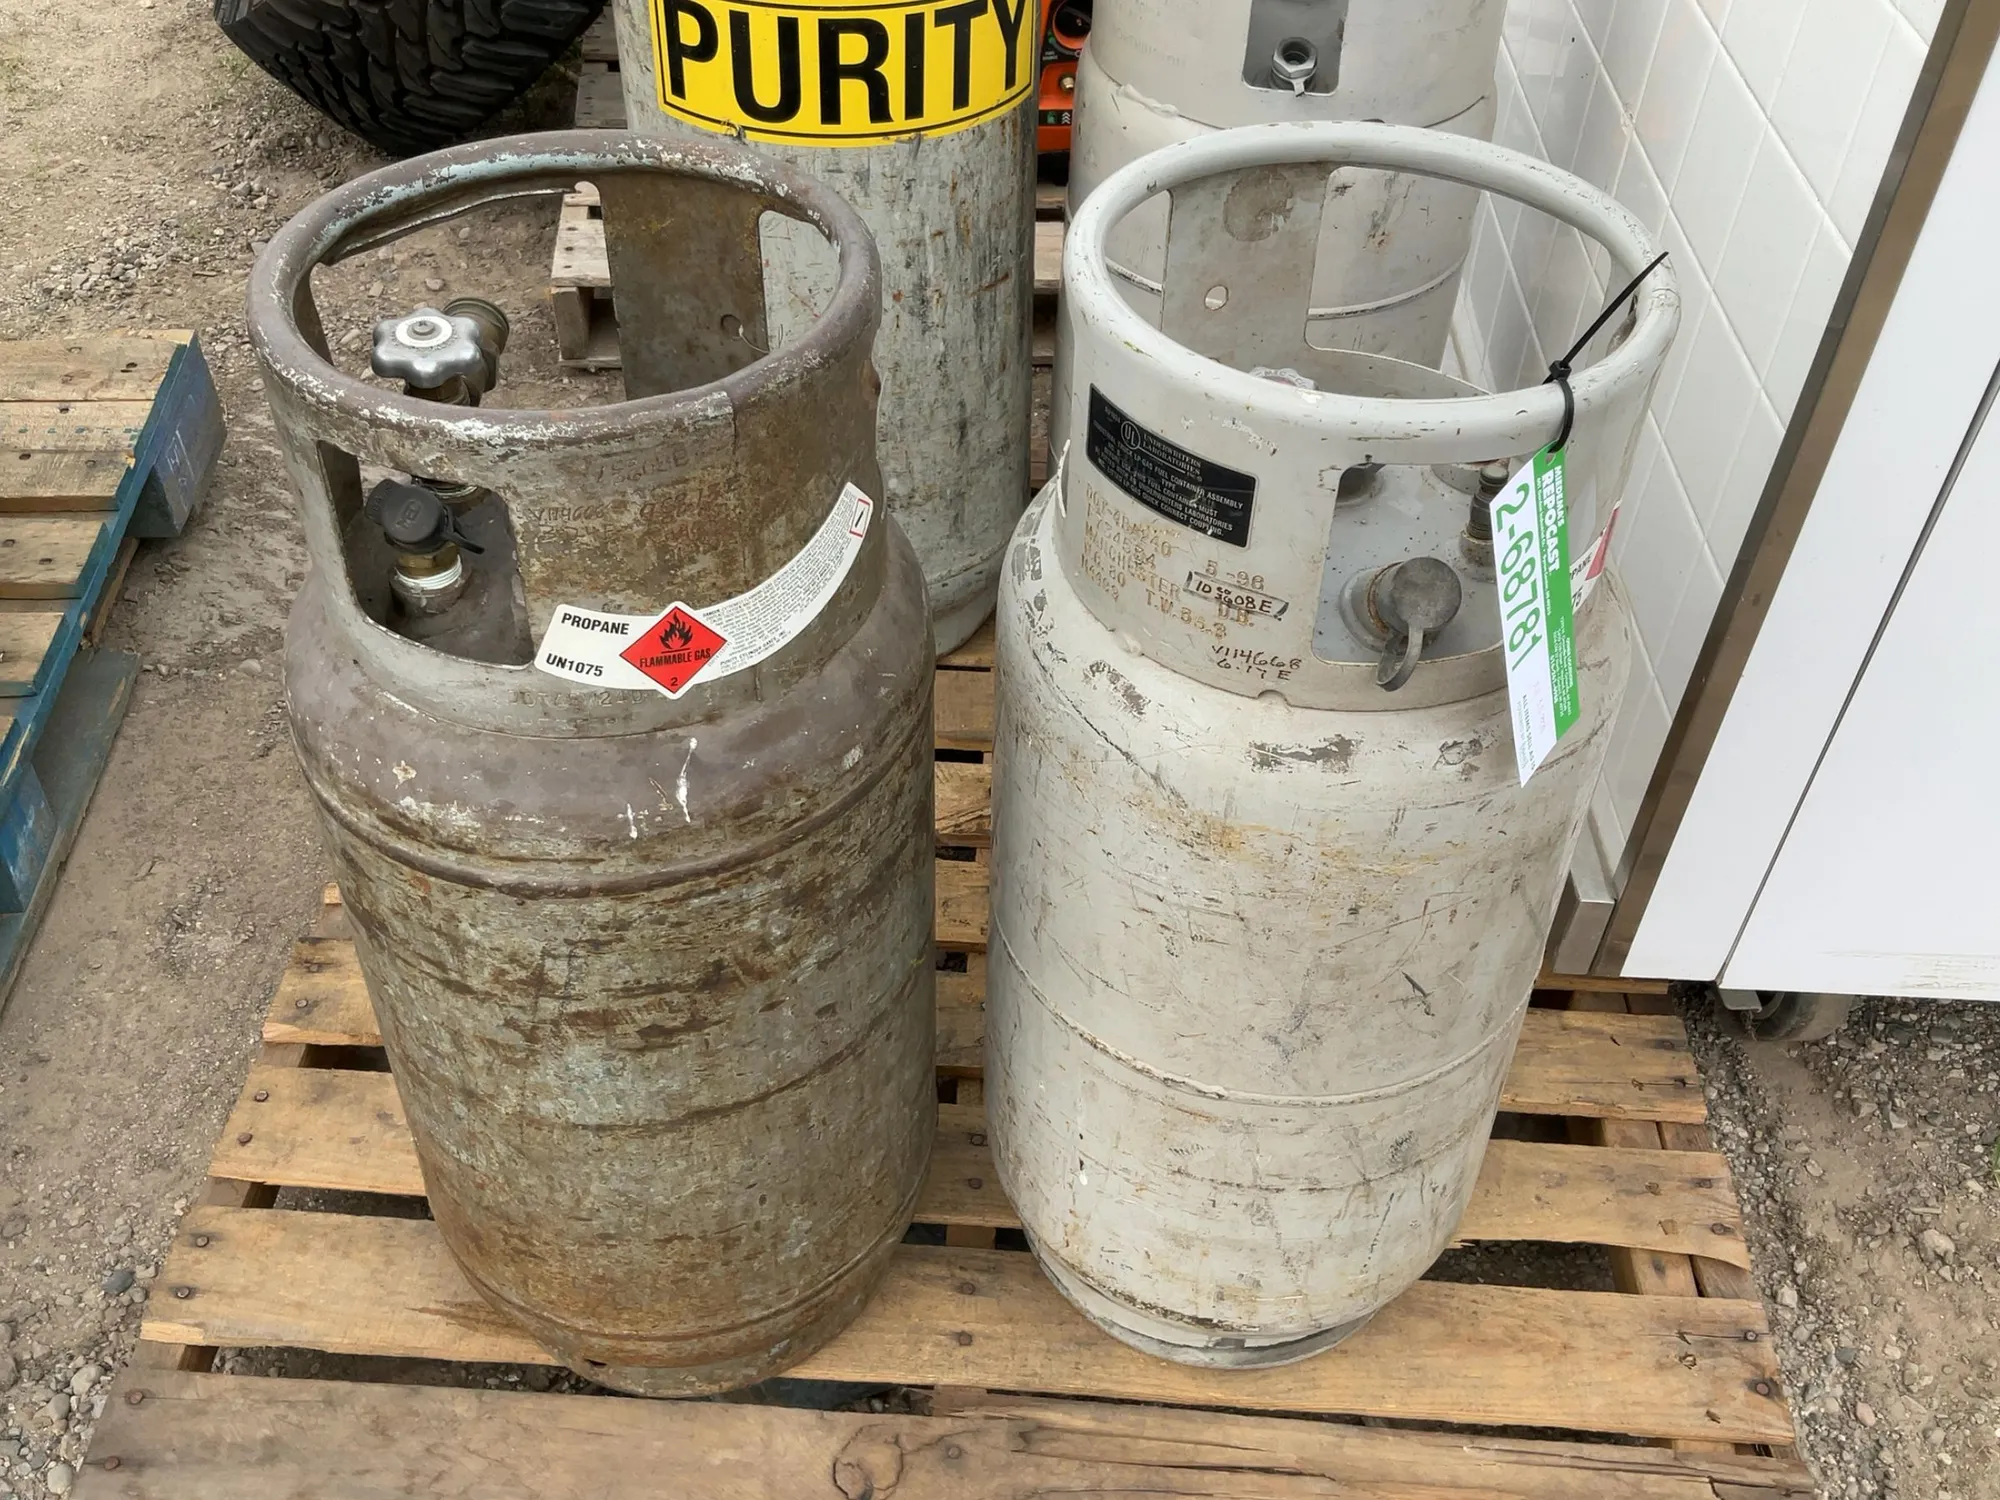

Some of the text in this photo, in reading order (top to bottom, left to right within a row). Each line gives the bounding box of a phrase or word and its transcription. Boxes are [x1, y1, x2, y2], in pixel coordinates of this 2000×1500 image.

[664, 0, 1026, 125] PURITY
[1142, 440, 1200, 475] LABORATORIES
[1143, 433, 1201, 467] UNDERWRITERS
[1154, 464, 1169, 478] FUEL
[1206, 491, 1244, 510] ASSEMBLY
[1161, 478, 1176, 491] TYPE
[1554, 465, 1565, 527] MIEDEMA'S
[1160, 500, 1188, 521] CONNECT
[1184, 506, 1233, 531] LABORATORIES
[1199, 503, 1218, 517] MUST
[1541, 469, 1560, 571] REPOCAST
[1496, 482, 1542, 671] 2-68781
[560, 612, 630, 636] PROPANE
[545, 652, 604, 677] UN1075
[639, 653, 693, 668] FLAMMABLE
[693, 647, 711, 662] GAS
[670, 677, 679, 687] 2
